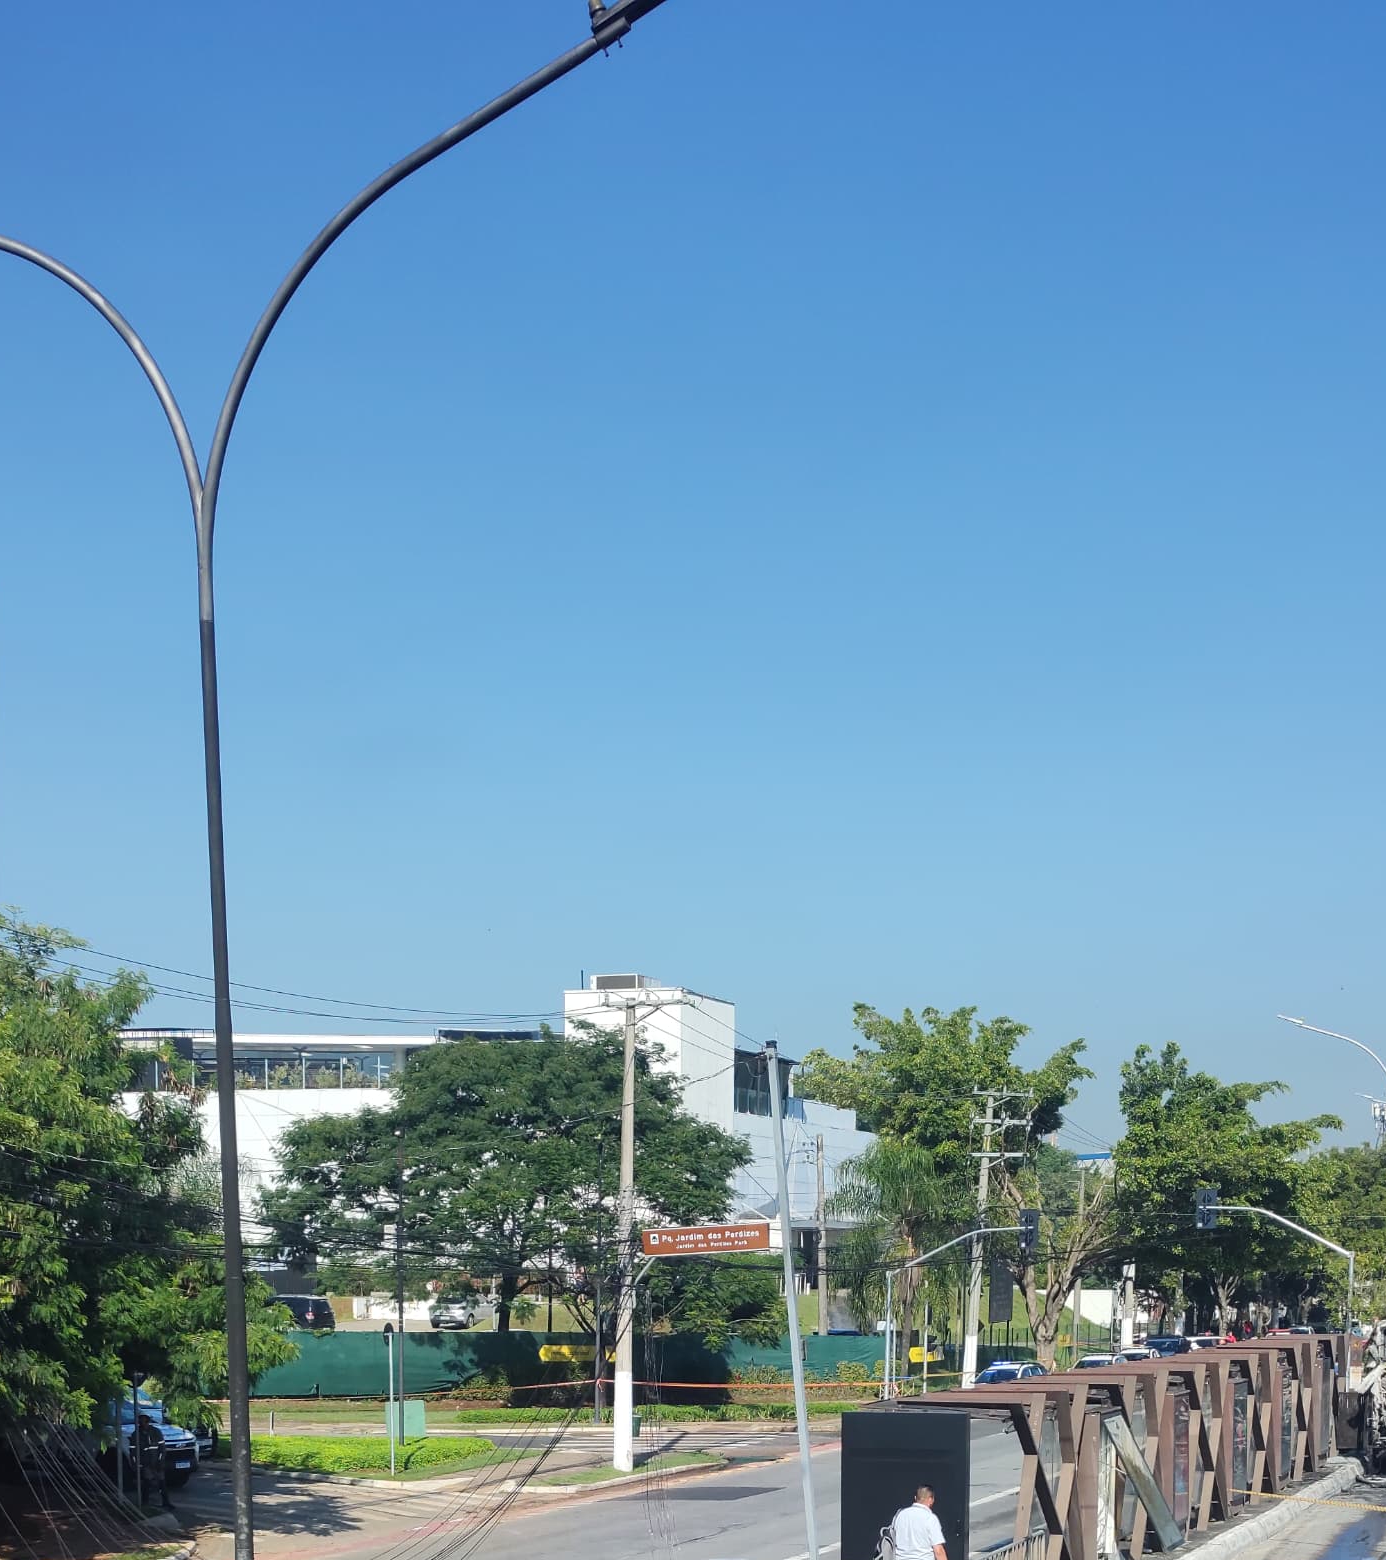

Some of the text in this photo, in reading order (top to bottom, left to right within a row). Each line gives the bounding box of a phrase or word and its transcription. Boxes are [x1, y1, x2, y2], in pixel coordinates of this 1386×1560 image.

[661, 1229, 760, 1243] Pq. Jardim das Perdizes
